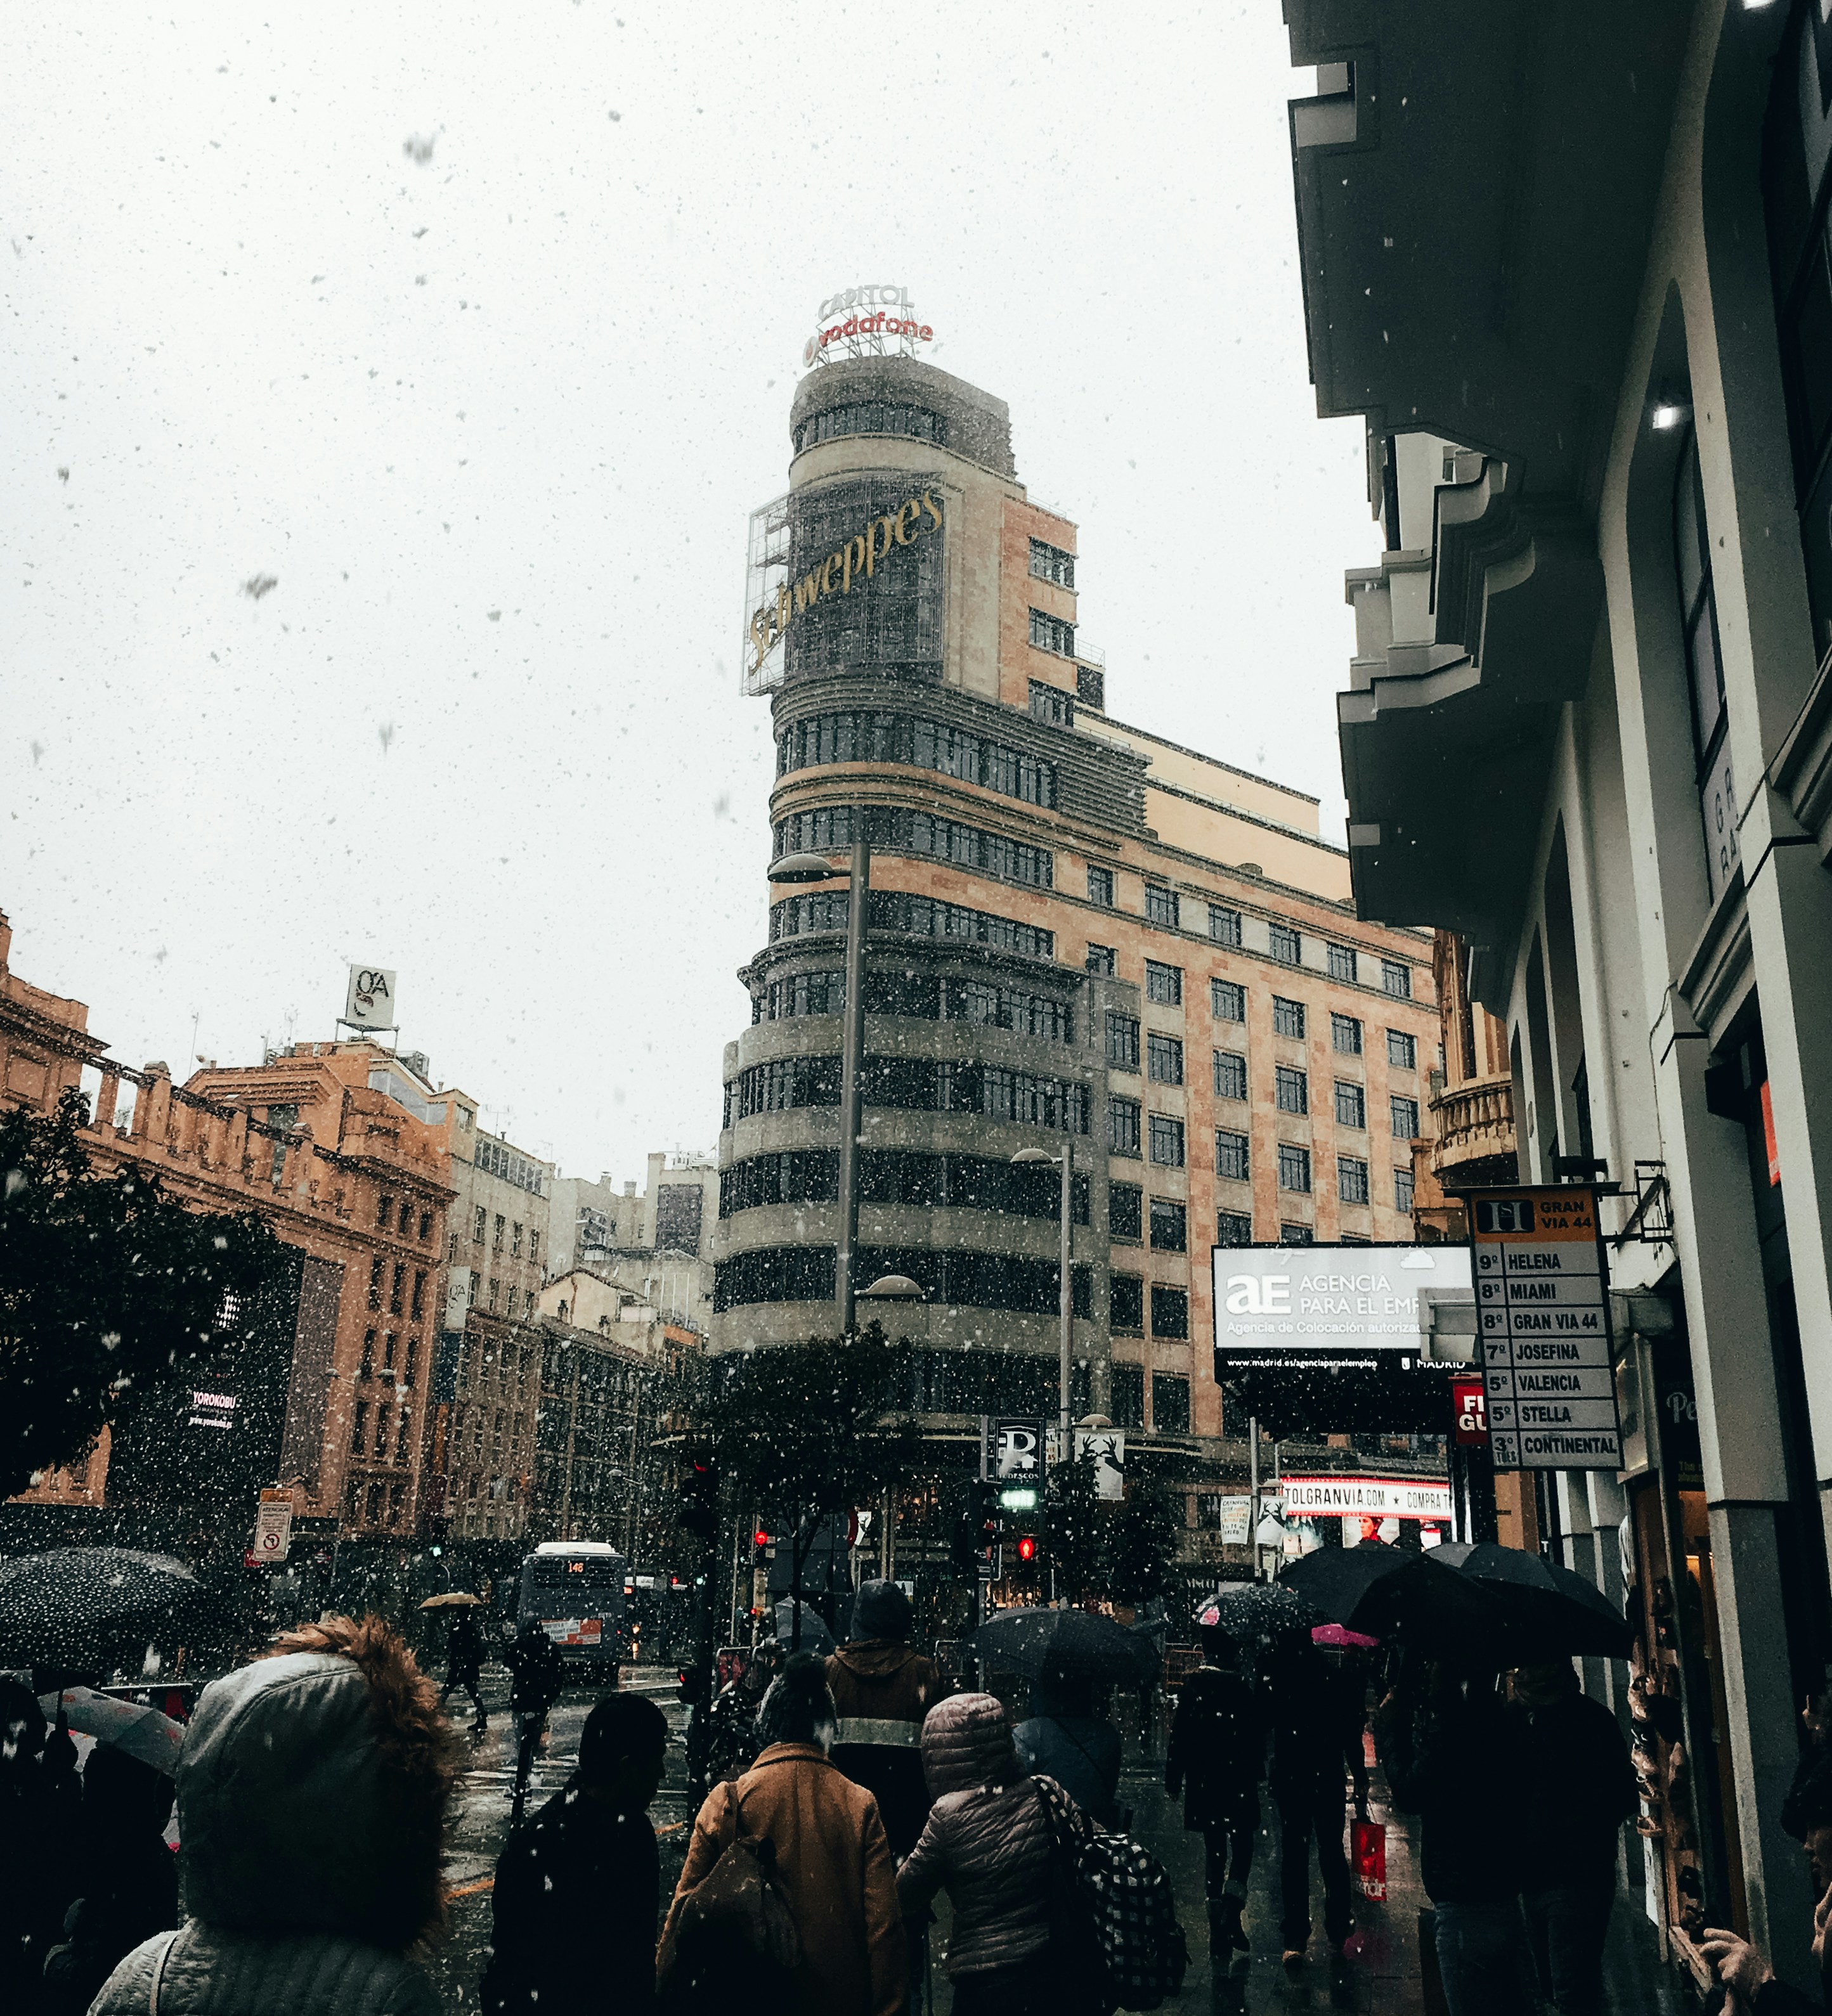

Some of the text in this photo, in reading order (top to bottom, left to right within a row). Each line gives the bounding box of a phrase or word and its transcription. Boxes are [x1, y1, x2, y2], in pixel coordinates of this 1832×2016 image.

[818, 285, 915, 320] CAPITOL
[819, 311, 933, 347] vodafone
[749, 491, 942, 676] Schweppes
[1540, 1201, 1584, 1213] GRAN
[1541, 1217, 1592, 1229] VIA 44
[1509, 1253, 1561, 1269] HELENA
[1299, 1274, 1392, 1292] AGENCIA
[1510, 1284, 1556, 1300] MIAMI
[1300, 1297, 1352, 1315] PARA
[1356, 1297, 1379, 1315] EL
[1226, 1322, 1276, 1336] Agencia
[1278, 1322, 1294, 1333] de
[1296, 1321, 1365, 1334] Colocación
[1514, 1314, 1551, 1330] GRAN
[1556, 1314, 1579, 1330] VIA
[1582, 1314, 1597, 1329] 44
[1516, 1344, 1580, 1360] JOSEFINA
[1519, 1375, 1582, 1392] VALENCIA
[193, 1391, 236, 1409] YOROKOBU
[1521, 1406, 1571, 1423] STELLA
[1524, 1437, 1618, 1455] CONTINENTAL
[1407, 1492, 1441, 1509] COMPRA
